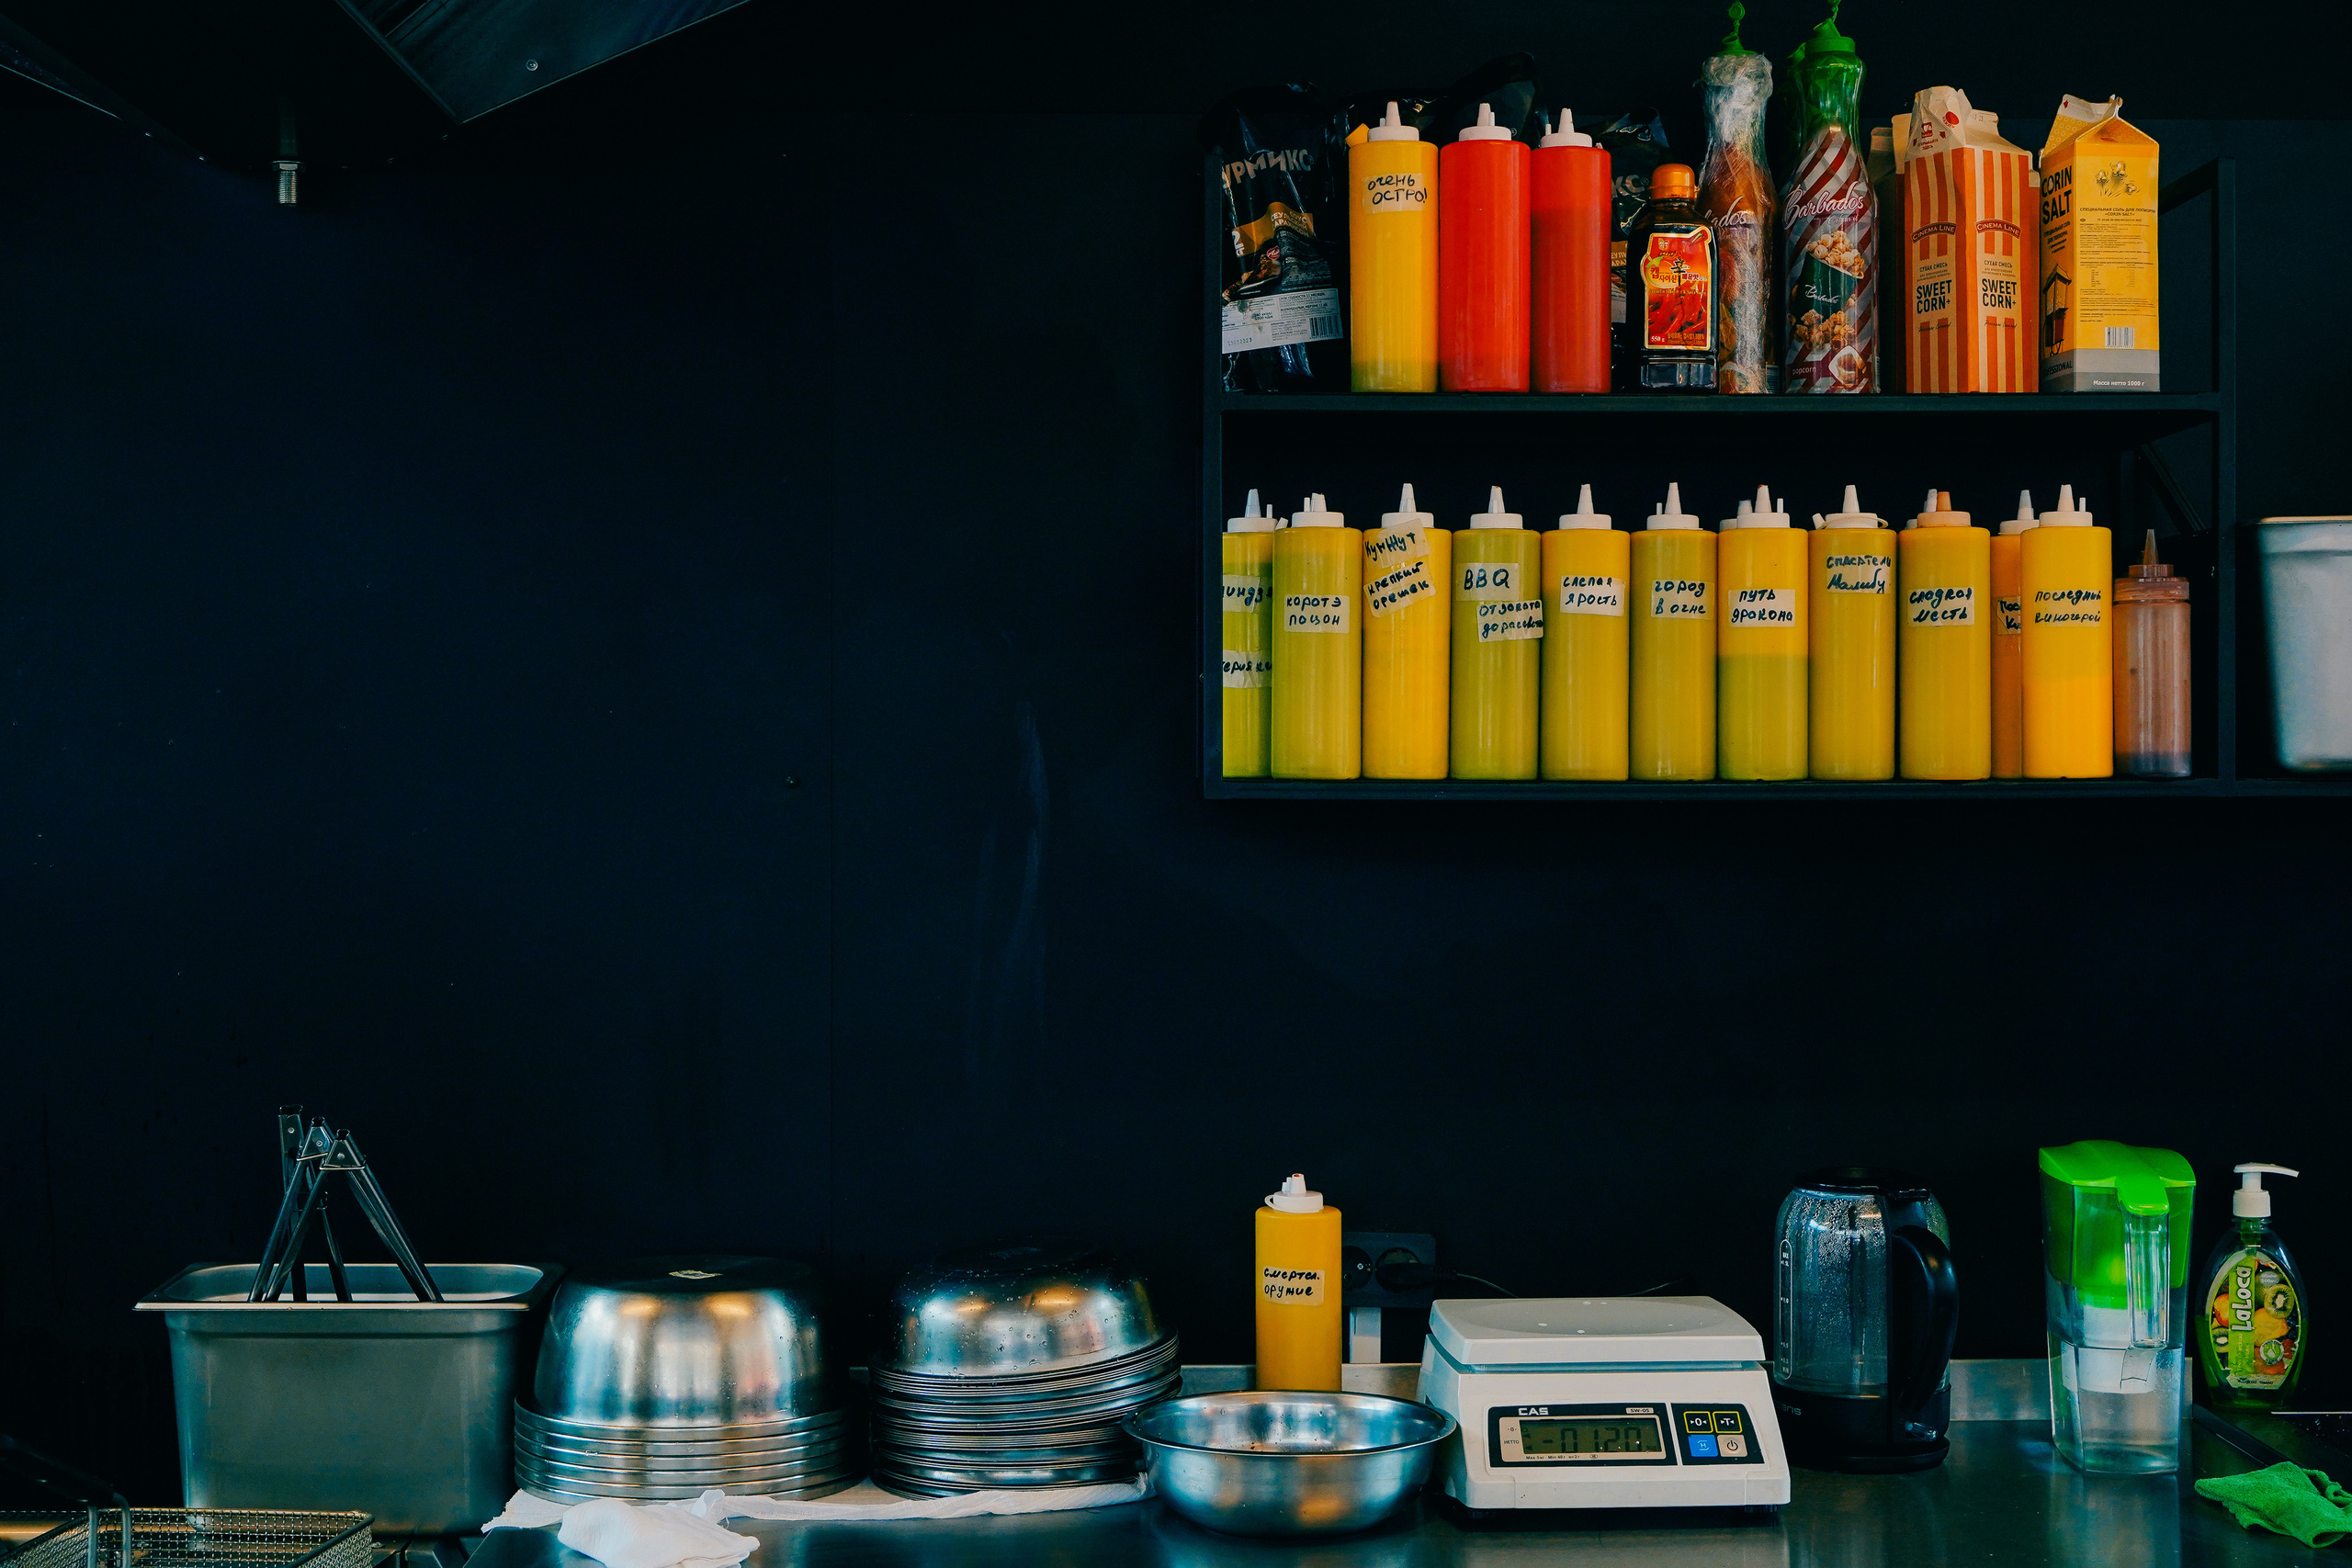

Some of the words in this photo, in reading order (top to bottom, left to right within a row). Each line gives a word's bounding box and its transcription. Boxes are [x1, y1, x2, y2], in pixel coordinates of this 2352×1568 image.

[2041, 165, 2072, 198] CORIN
[1785, 181, 1865, 231] Barbados
[2042, 189, 2072, 225] SALT
[1912, 227, 1939, 242] CINEMA
[1939, 224, 1956, 233] LINE
[1976, 222, 2004, 231] CINEMA
[2004, 224, 2021, 237] LINE
[1917, 279, 1952, 300] SWEET
[1982, 277, 2018, 296] SWEET
[1917, 295, 1951, 314] CORN+
[1982, 292, 2017, 310] CORN+
[1792, 367, 1817, 375] popcorn
[1464, 568, 1510, 591] BBQ
[2231, 1266, 2252, 1331] LaLoca
[1518, 1407, 1549, 1416] CAS
